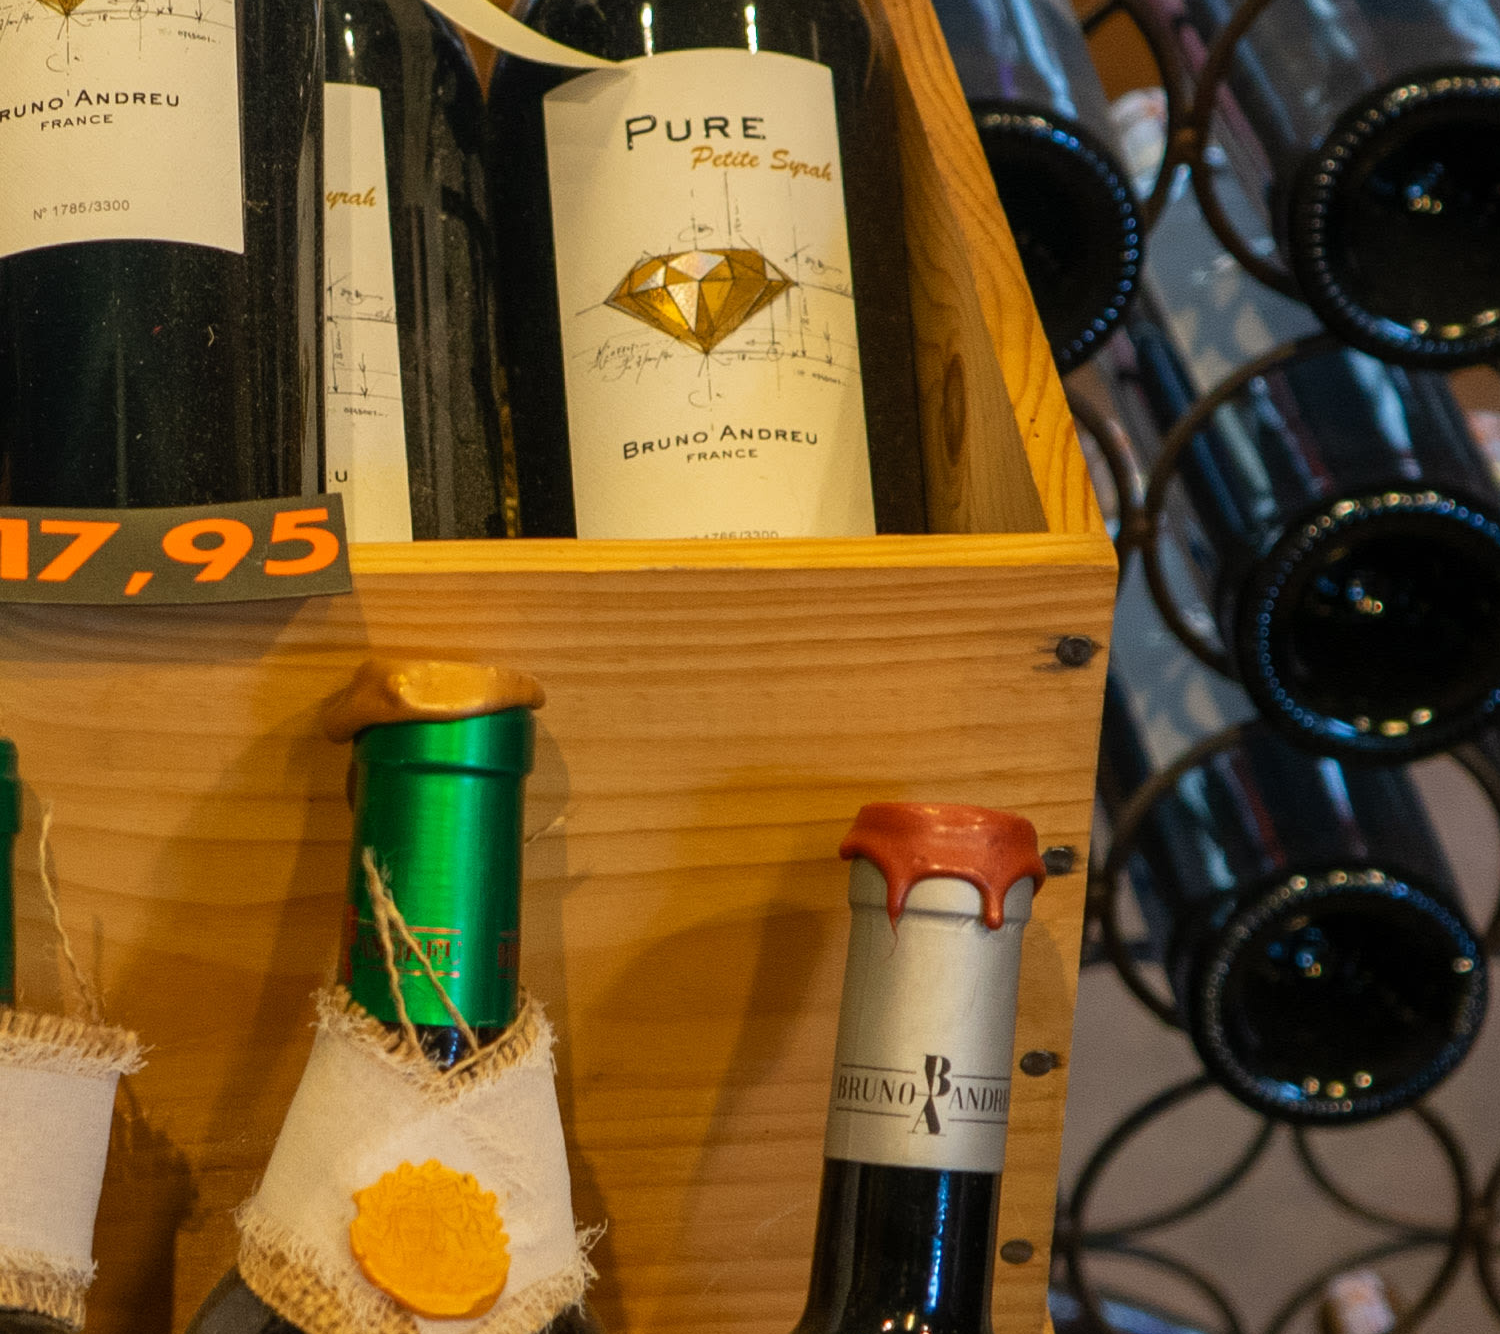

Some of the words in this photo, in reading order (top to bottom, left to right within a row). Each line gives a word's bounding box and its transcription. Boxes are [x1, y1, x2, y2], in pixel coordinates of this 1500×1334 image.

[74, 89, 181, 107] ANDREU
[40, 113, 114, 132] FRANCE
[626, 115, 767, 151] PURE
[691, 146, 760, 171] Petite
[770, 149, 832, 182] Syrah
[326, 187, 377, 212] yrah
[623, 430, 709, 460] BRUNO
[719, 425, 819, 445] ANDREU
[686, 448, 760, 463] FRANCE
[837, 1074, 917, 1106] BRUNO
